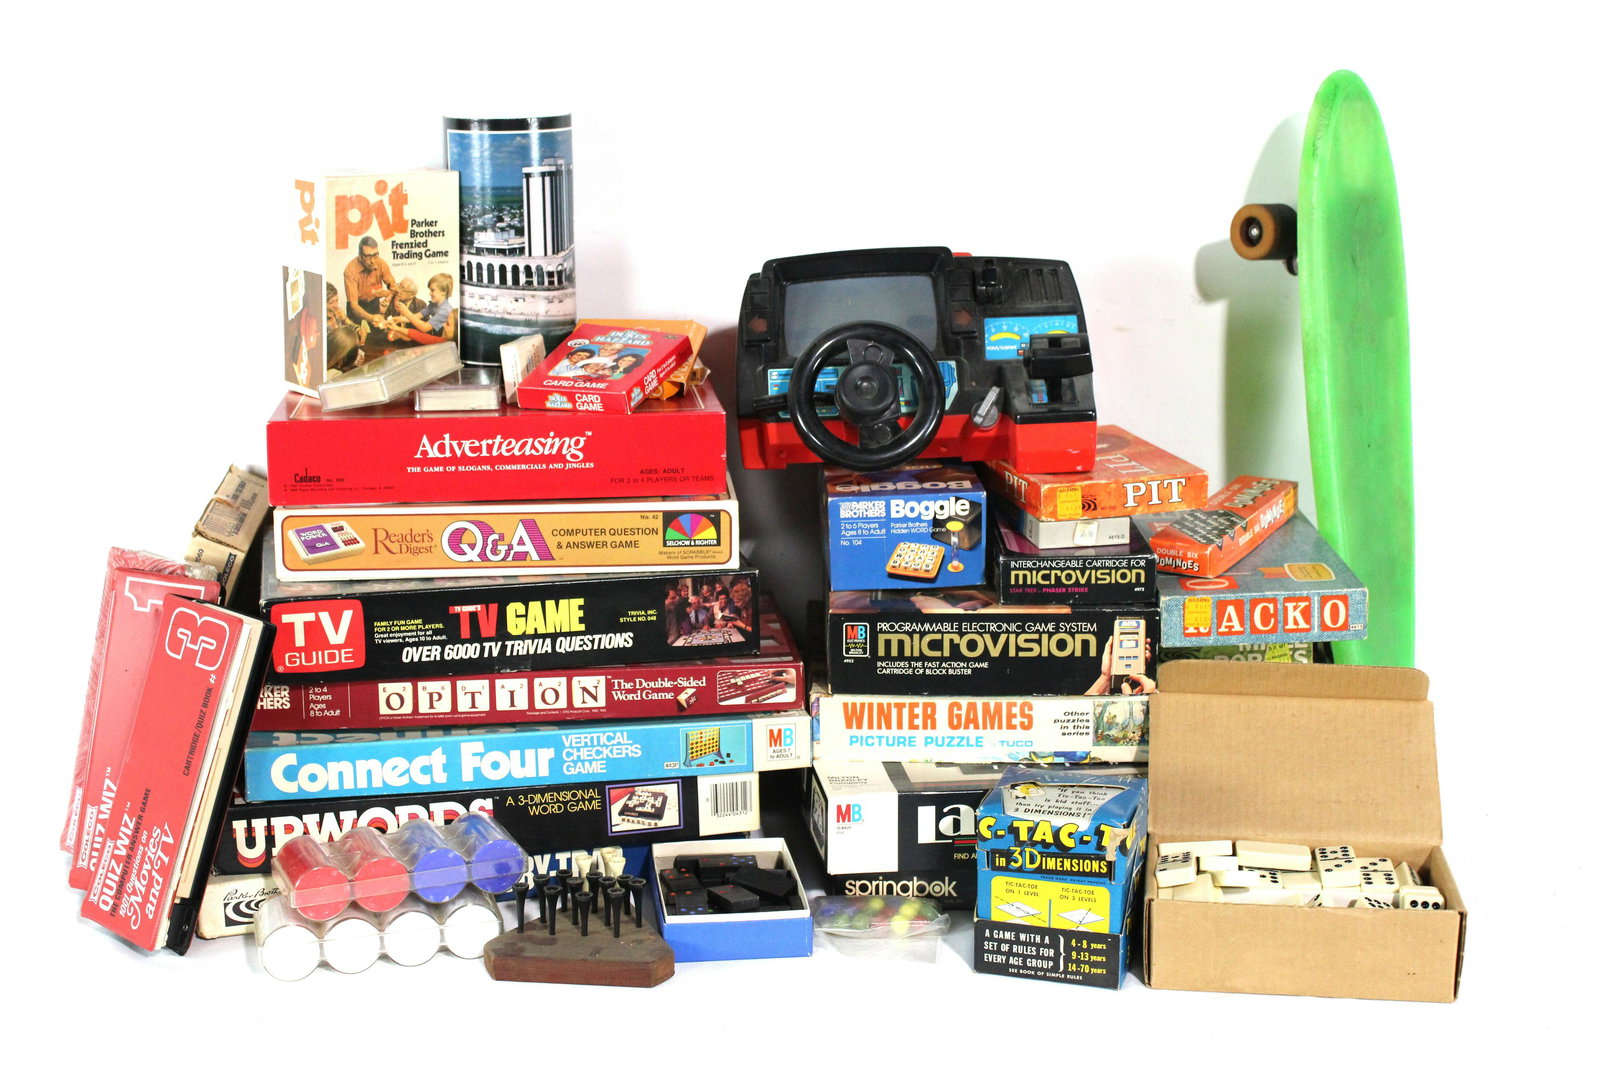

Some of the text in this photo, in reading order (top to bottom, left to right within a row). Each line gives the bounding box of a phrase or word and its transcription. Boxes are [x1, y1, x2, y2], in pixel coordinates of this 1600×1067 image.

[295, 179, 320, 245] pit
[335, 180, 409, 249] pit
[411, 218, 438, 228] Parker
[410, 229, 445, 238] Brothers
[391, 239, 428, 249] Frenzied
[392, 249, 449, 260] Trading Game
[595, 336, 651, 345] HAZZARD
[543, 379, 609, 389] CARD GAME
[575, 394, 600, 403] CARD
[576, 402, 604, 411] GAME
[414, 431, 587, 462] Adverteasing
[457, 464, 493, 472] SLOGANS,
[495, 463, 546, 471] COMMERCIALS
[565, 462, 594, 470] JINGLES
[1096, 454, 1156, 475] PIT
[294, 467, 321, 483] Cadaco
[1004, 470, 1029, 504] PIT
[1123, 478, 1187, 508] PIT
[852, 500, 886, 511] PARKER
[890, 496, 970, 521] Boggle
[840, 509, 886, 519] BROTHERS
[551, 527, 659, 537] COMPUTER QUESTION
[841, 529, 857, 537] Ages
[869, 527, 886, 535] Adult
[857, 521, 879, 530] Players
[372, 526, 434, 555] Reader's
[440, 520, 556, 562] Q&A
[556, 540, 640, 550] & ANSWER GAME
[399, 543, 434, 557] Digest
[1156, 547, 1199, 559] DOUBLE SIX
[1010, 559, 1146, 569] INTERCHANGEABLE CARTRIDGE FOR
[1010, 569, 1146, 585] microvision
[448, 597, 586, 639] TV GAME
[281, 610, 354, 648] TV
[846, 625, 867, 640] MB
[877, 622, 1097, 632] PROGRAMMABLE ELECTRONIC GAME SYSTEM
[165, 607, 230, 671] 3
[877, 633, 1097, 658] microvision
[402, 632, 634, 664] OVER 6000 TV TRIVIA QUESTIONS
[285, 648, 355, 667] GUIDE
[611, 676, 707, 690] The Double-Sided
[309, 694, 332, 702] Players
[611, 689, 675, 702] Word Game
[309, 702, 326, 711] Ages
[843, 700, 1034, 731] WINTER GAMES
[561, 731, 633, 748] VERTICAL
[769, 727, 794, 748] MB
[849, 735, 1034, 748] PICTURE PUZZLE TUCO
[562, 744, 642, 761] CHECKERS
[270, 741, 555, 794] Connect Four
[562, 760, 607, 775] GAME
[506, 789, 602, 807] A 3-DIMENSIONAL
[528, 800, 602, 817] WORD GAME
[836, 803, 863, 823] MB
[110, 786, 152, 917] THE COMPUTER ANSWER GAME
[953, 852, 970, 860] FIND
[98, 813, 136, 912] QUIZ WIZ
[145, 821, 174, 920] and TV
[93, 844, 111, 898] COLECO
[126, 825, 162, 930] Movies
[845, 876, 957, 897] springbok
[1005, 881, 1038, 890] TIC-TAC-TOE
[1061, 887, 1095, 896] TIC-TAC-TOE
[985, 928, 1050, 945] A GAME WITH A
[984, 941, 1055, 958] SET OF RULES FOR
[984, 953, 1054, 969] EVERY AGE GROUP
